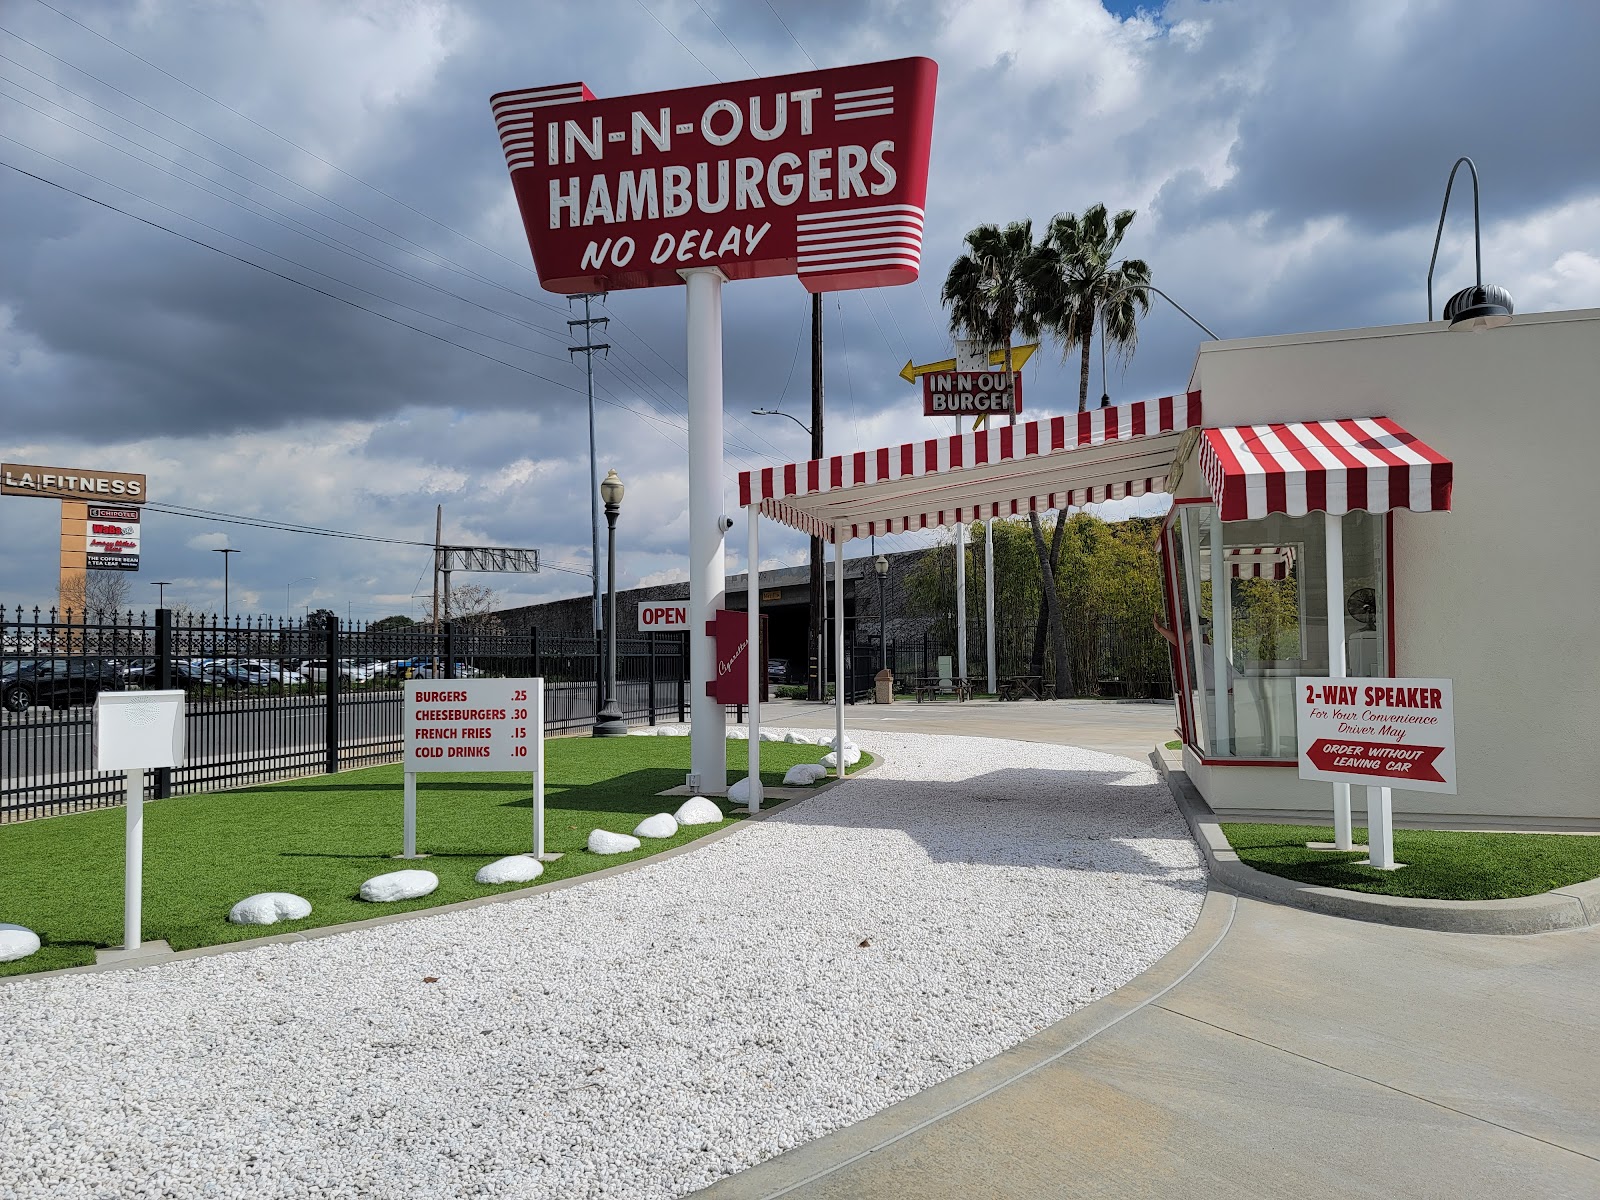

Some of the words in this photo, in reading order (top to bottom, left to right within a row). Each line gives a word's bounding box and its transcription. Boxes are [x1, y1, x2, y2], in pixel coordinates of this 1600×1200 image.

[548, 87, 823, 165] IN-N-OUT
[549, 139, 897, 229] HAMBURGERS
[580, 236, 636, 270] NO
[649, 221, 772, 264] DELAY
[5, 471, 36, 488] LA
[42, 474, 141, 495] FITNESS
[642, 607, 686, 625] OPEN
[415, 691, 467, 702] BURGERS
[511, 690, 527, 701] .25
[1306, 685, 1358, 706] 2-WAY
[1364, 686, 1442, 709] SPEAKER
[415, 709, 506, 720] CHEESEBURGERS
[511, 709, 527, 720] .30
[1310, 708, 1328, 719] For
[1332, 709, 1358, 720] Your
[1362, 710, 1438, 725] Convenience
[415, 728, 457, 739] FRENCH
[462, 728, 492, 738] FRIES
[511, 727, 527, 738] .15
[1338, 723, 1375, 735] Driver
[1378, 725, 1407, 742] May
[415, 747, 443, 757] COLD
[448, 746, 490, 757] DRINKS
[511, 746, 527, 757] .10
[1323, 744, 1363, 756] ORDER
[1368, 748, 1425, 761] WITHOUT
[1333, 757, 1380, 769] LEAVING
[1385, 761, 1412, 772] CAR
